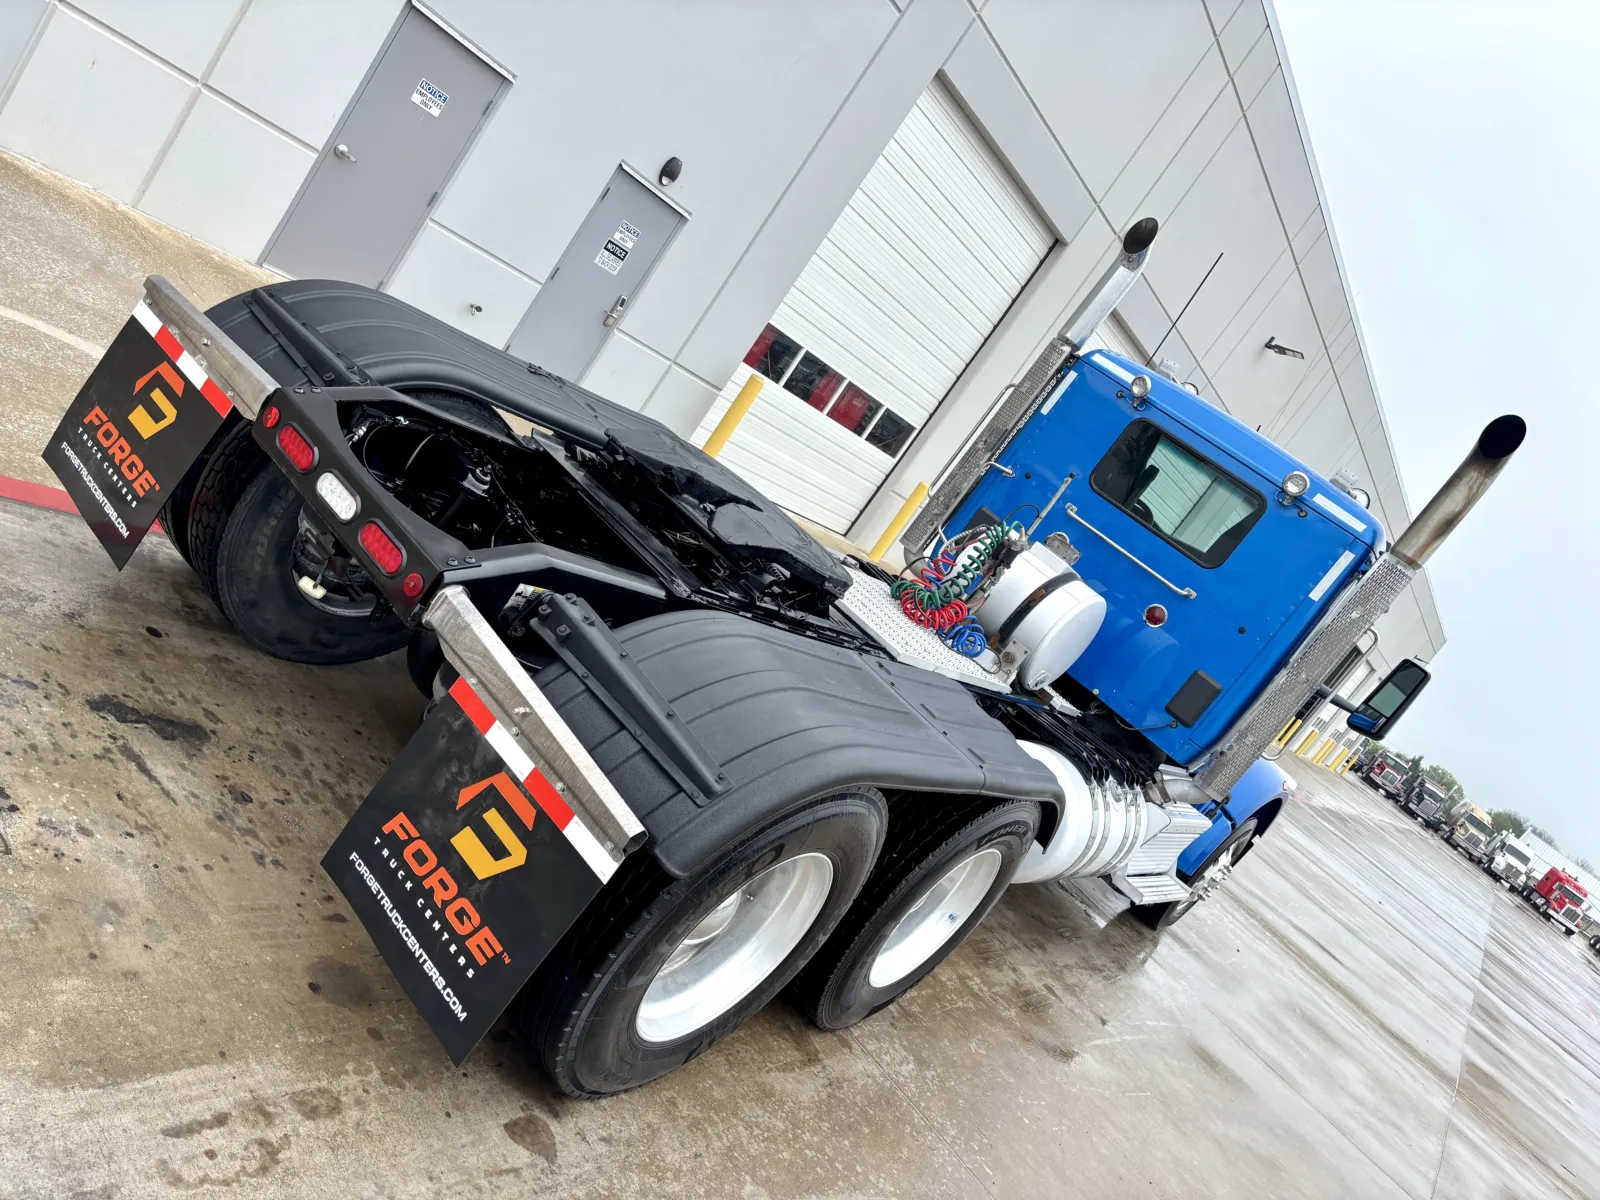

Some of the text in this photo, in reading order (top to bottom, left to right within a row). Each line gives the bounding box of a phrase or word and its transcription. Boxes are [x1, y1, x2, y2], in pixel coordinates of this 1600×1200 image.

[415, 88, 443, 110] EMPLOYEES
[420, 99, 433, 110] ONLY
[421, 81, 447, 103] NOTICE
[606, 242, 626, 258] NOTICE
[621, 222, 639, 238] NOTICE
[60, 441, 130, 539] FORGETRUCKCENTERS.COM
[77, 427, 137, 508] TRUCK CENTERS
[83, 406, 155, 498] FORGE
[373, 837, 475, 979] TRUCK CENTERS
[381, 811, 503, 967] FORGE
[348, 851, 468, 1023] FORGETRUCKCENTERS.COM
